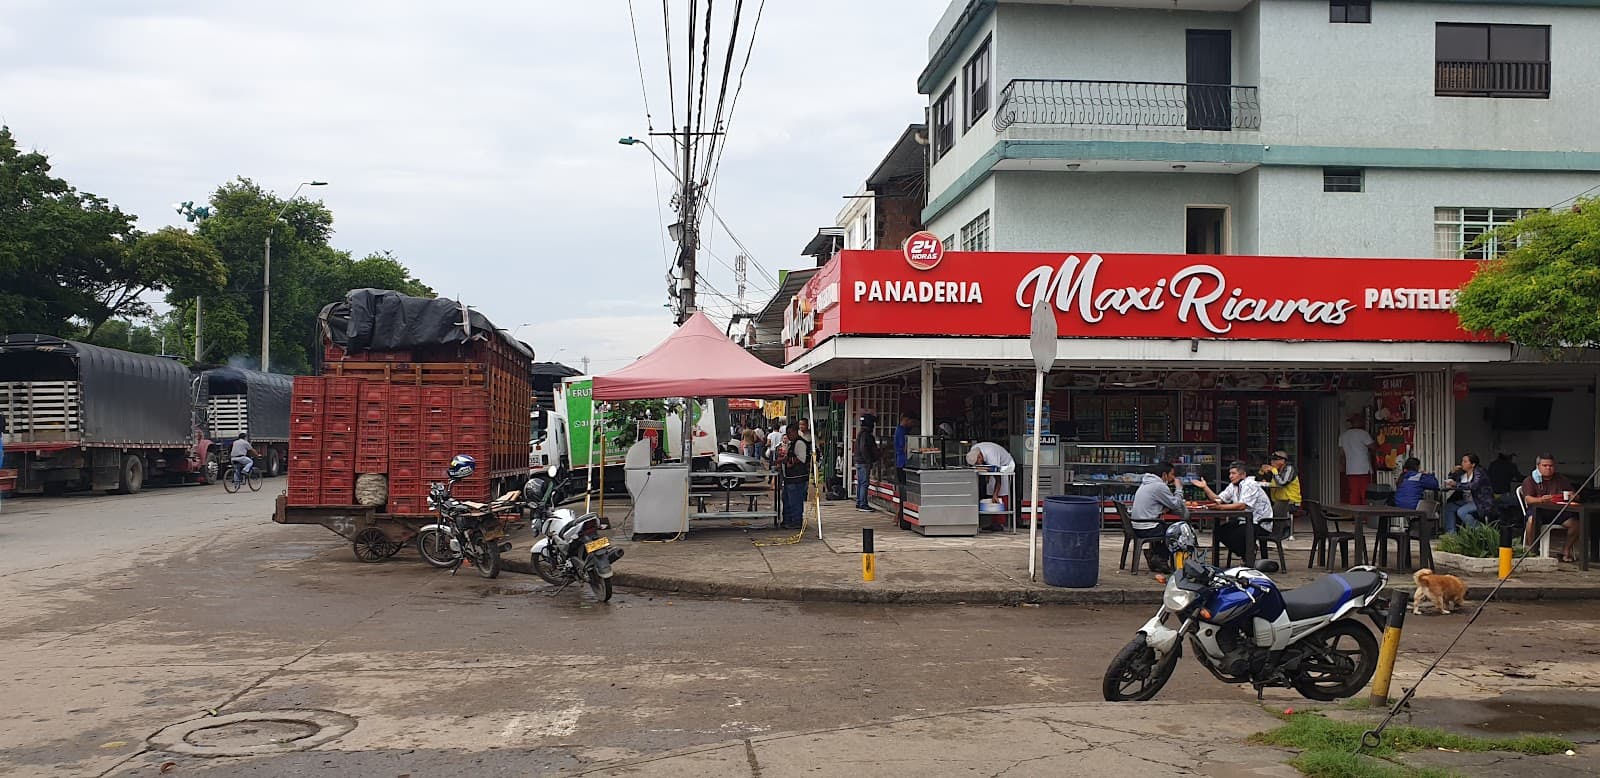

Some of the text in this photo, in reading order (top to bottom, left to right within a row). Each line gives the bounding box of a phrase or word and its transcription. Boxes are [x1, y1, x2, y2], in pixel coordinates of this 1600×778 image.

[911, 239, 938, 253] 24
[854, 280, 983, 304] PANADERIA
[1015, 254, 1357, 334] Maxi Ricuras
